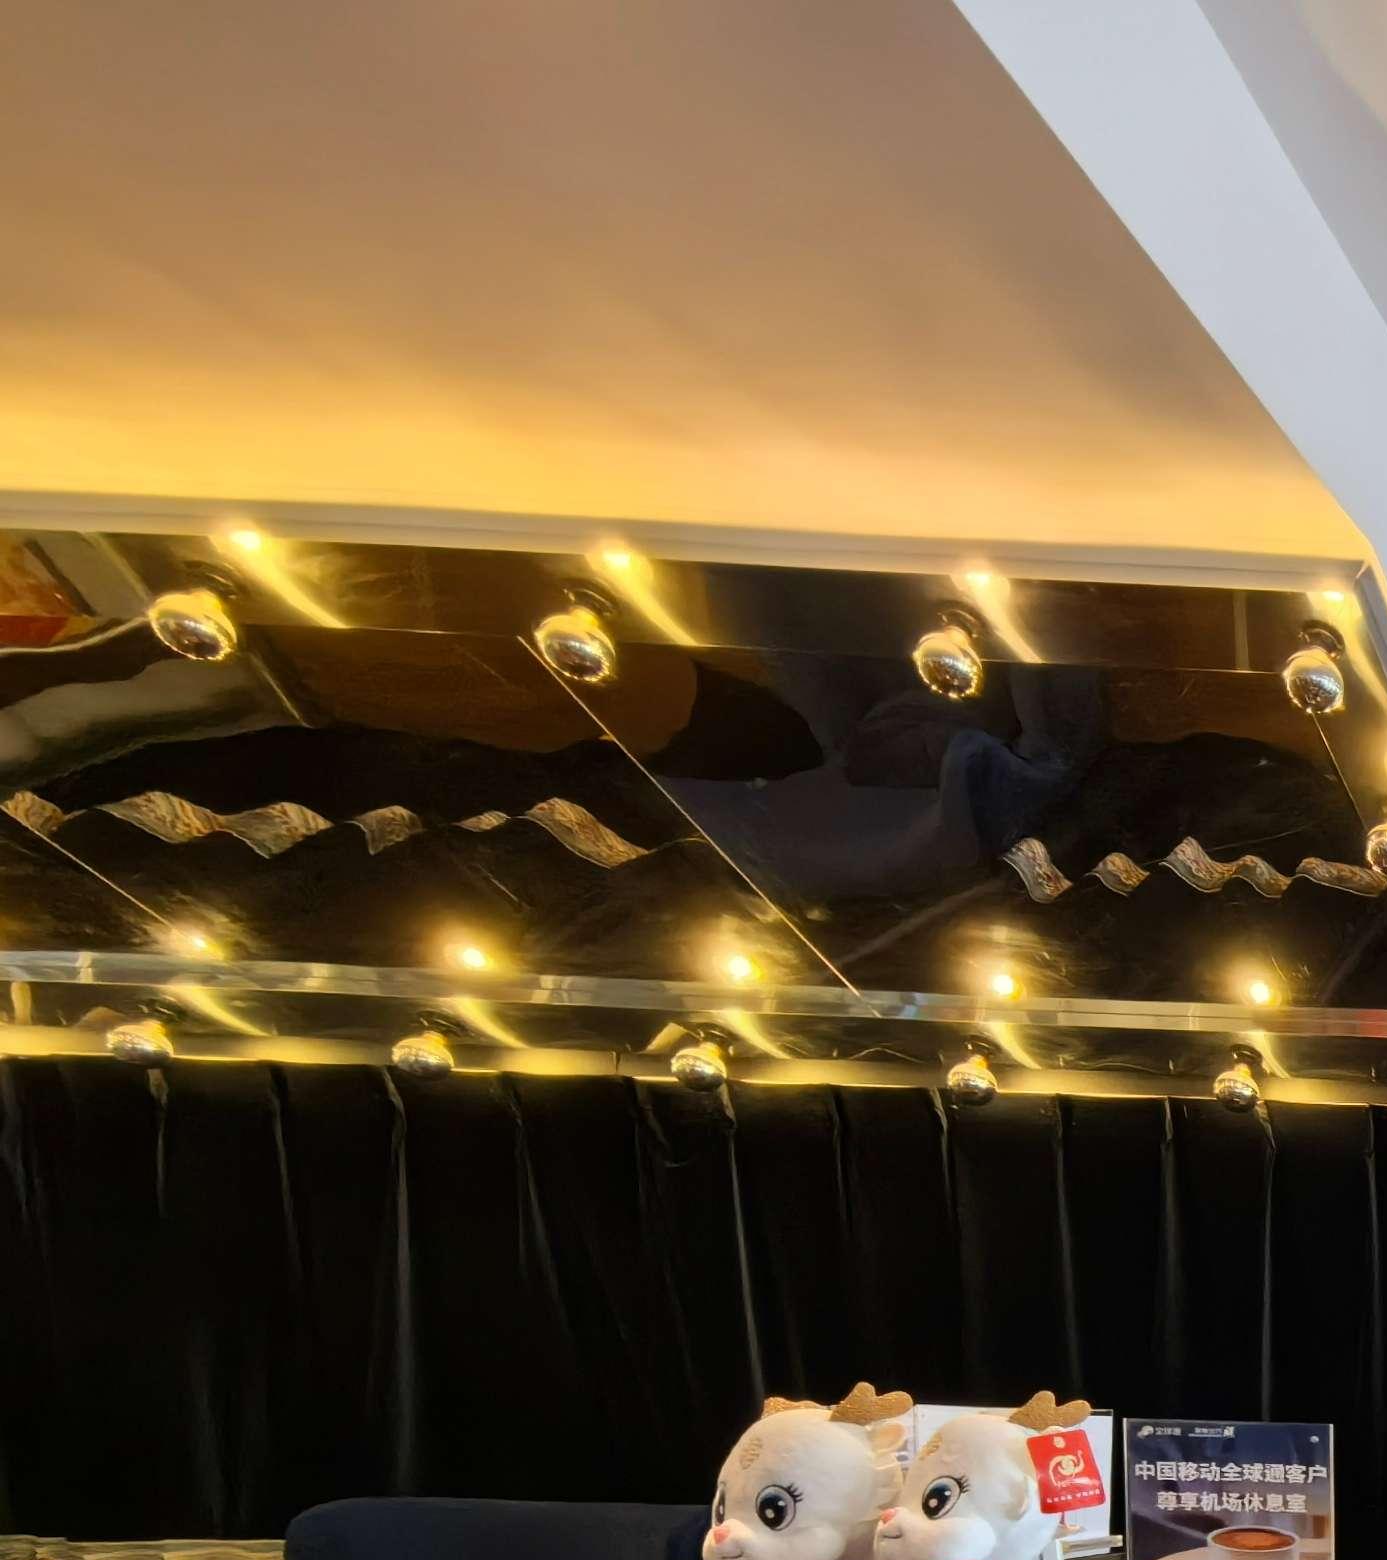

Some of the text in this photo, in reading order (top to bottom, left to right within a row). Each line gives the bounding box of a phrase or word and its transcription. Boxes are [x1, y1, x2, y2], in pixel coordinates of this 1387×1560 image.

[1133, 1460, 1329, 1484] 中国移动全球通客户
[1156, 1491, 1308, 1514] 尊享机场休息室
